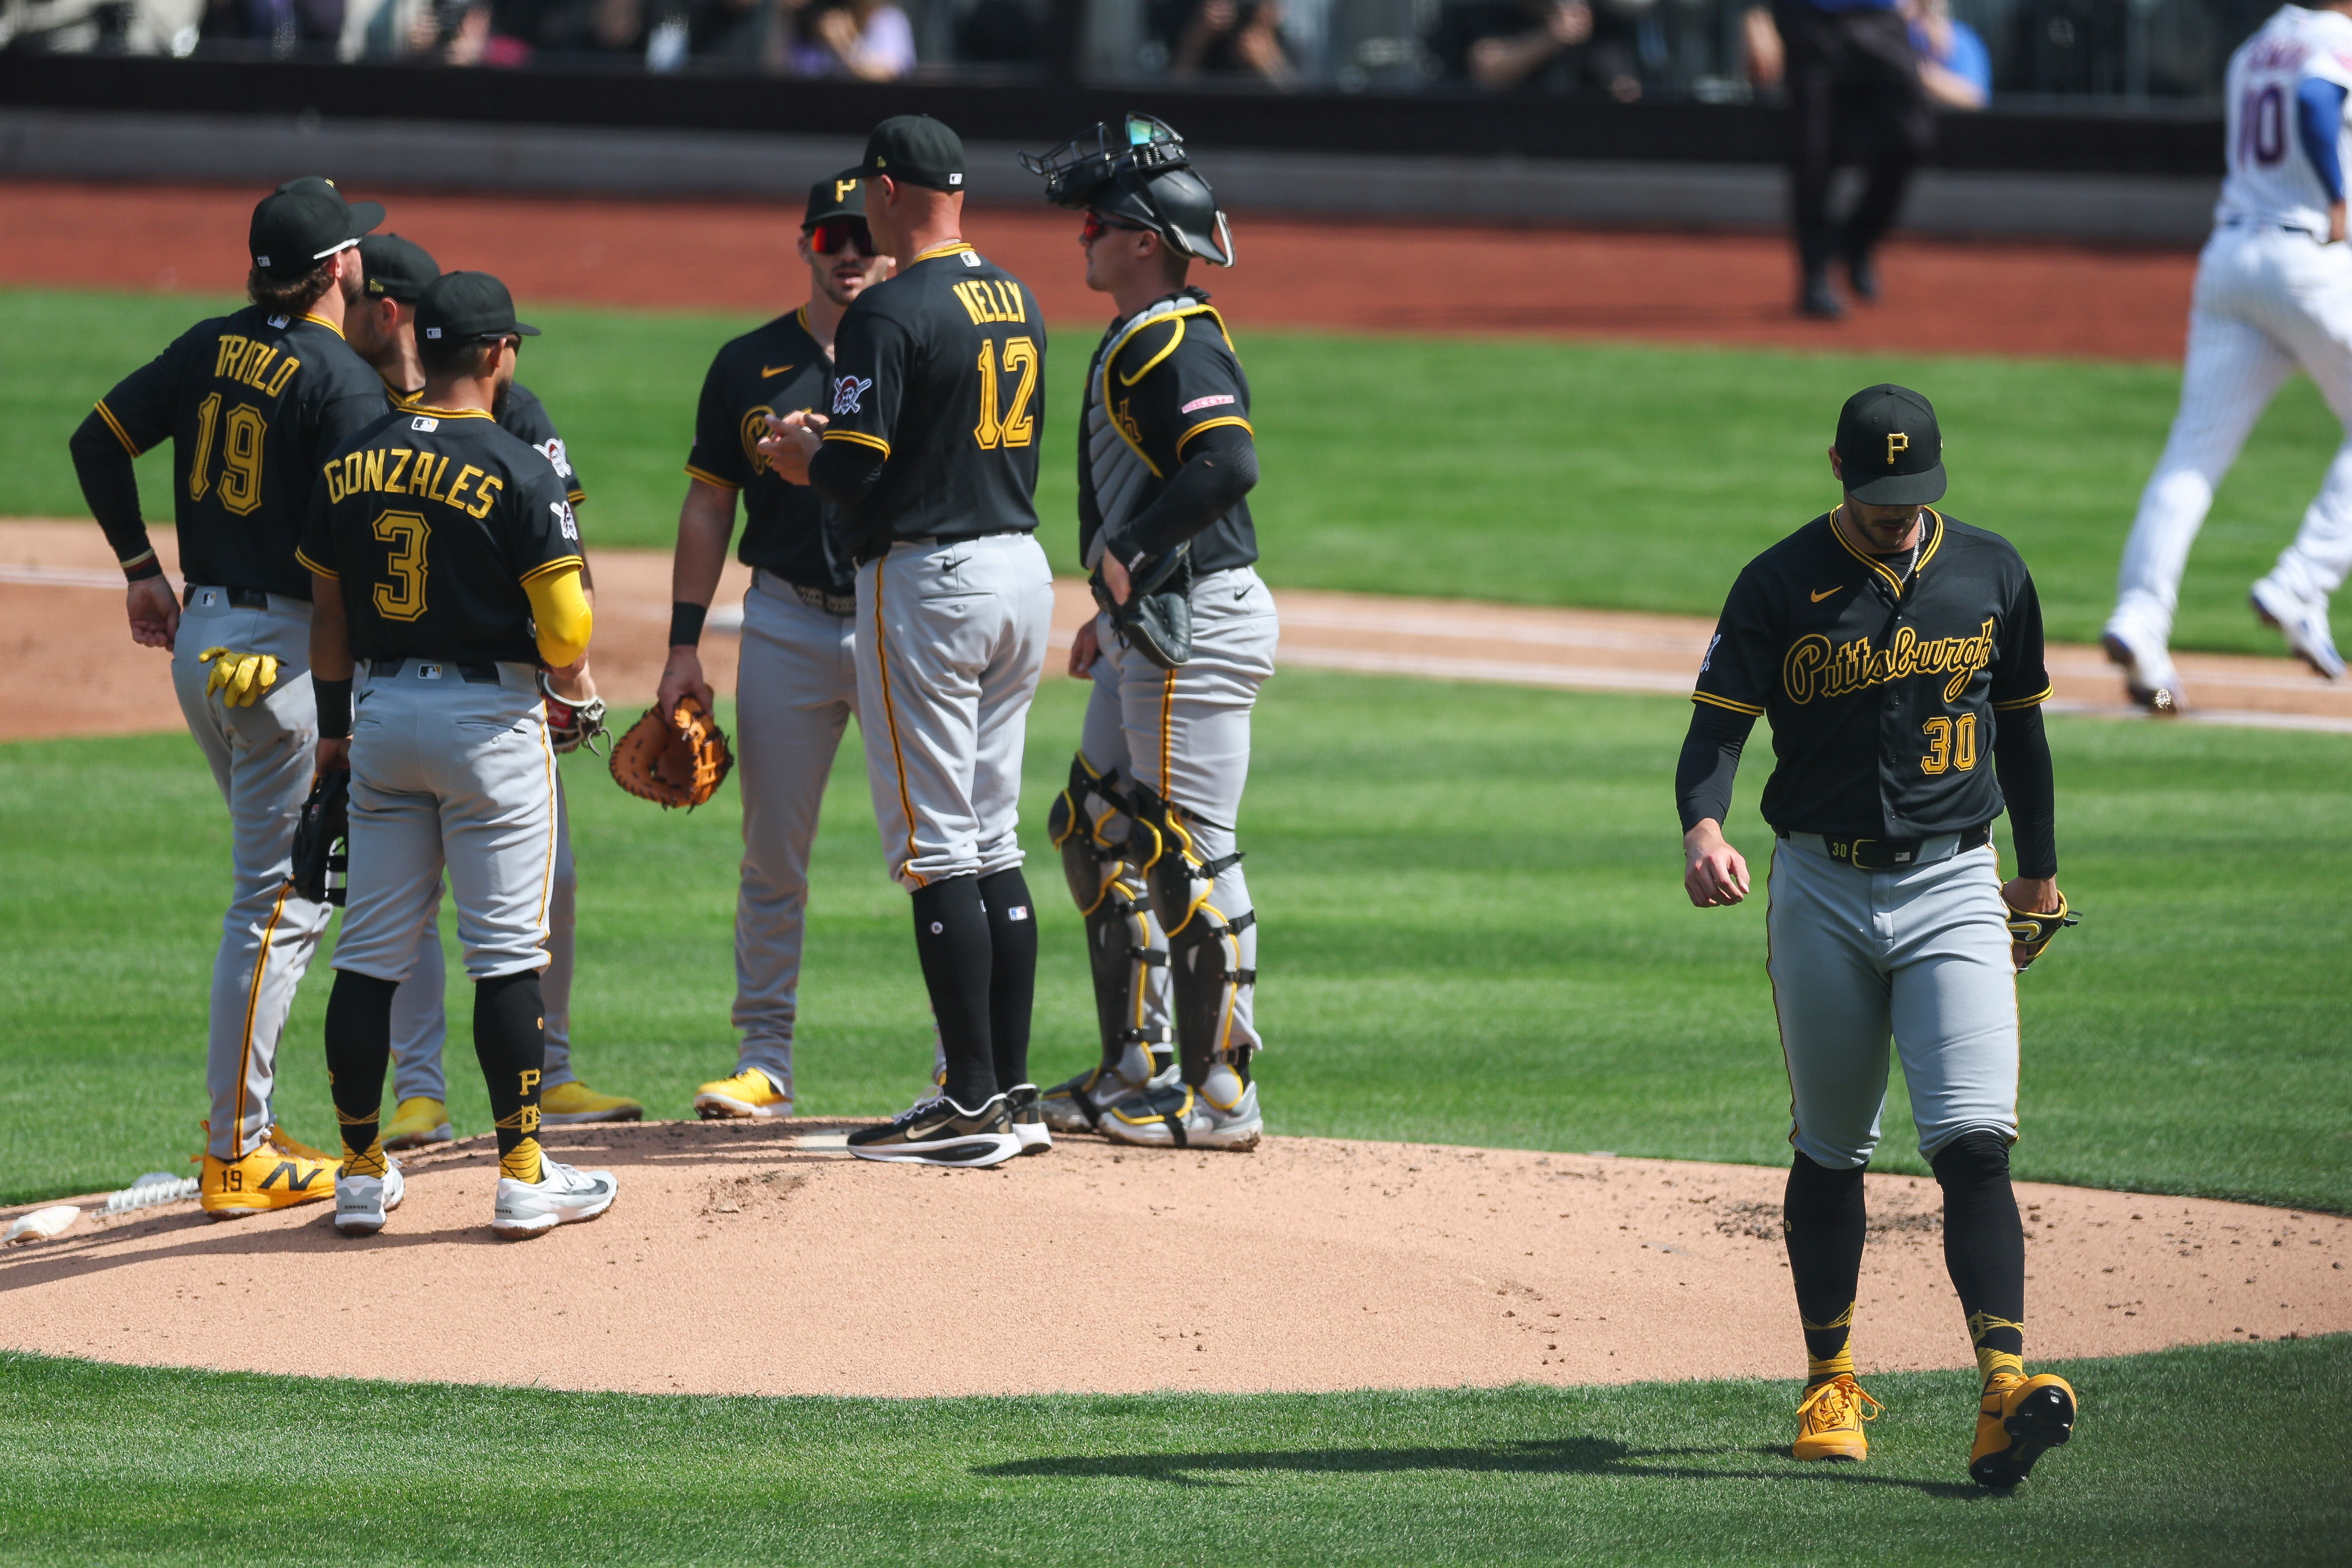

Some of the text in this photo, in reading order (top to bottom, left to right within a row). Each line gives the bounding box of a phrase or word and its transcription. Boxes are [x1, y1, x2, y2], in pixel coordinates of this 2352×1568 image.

[952, 280, 1026, 326] KELLY
[215, 335, 300, 398] TRIOLO
[974, 336, 1038, 450] 12
[189, 392, 268, 516] 19
[1887, 432, 1908, 464] P
[323, 448, 503, 519] GONZALES
[372, 509, 431, 622] 3
[1783, 616, 1994, 705] Pittsburgh
[1920, 713, 1978, 775] 30
[1832, 842, 1847, 857] 30
[519, 1068, 540, 1096] P
[221, 1170, 243, 1192] 19
